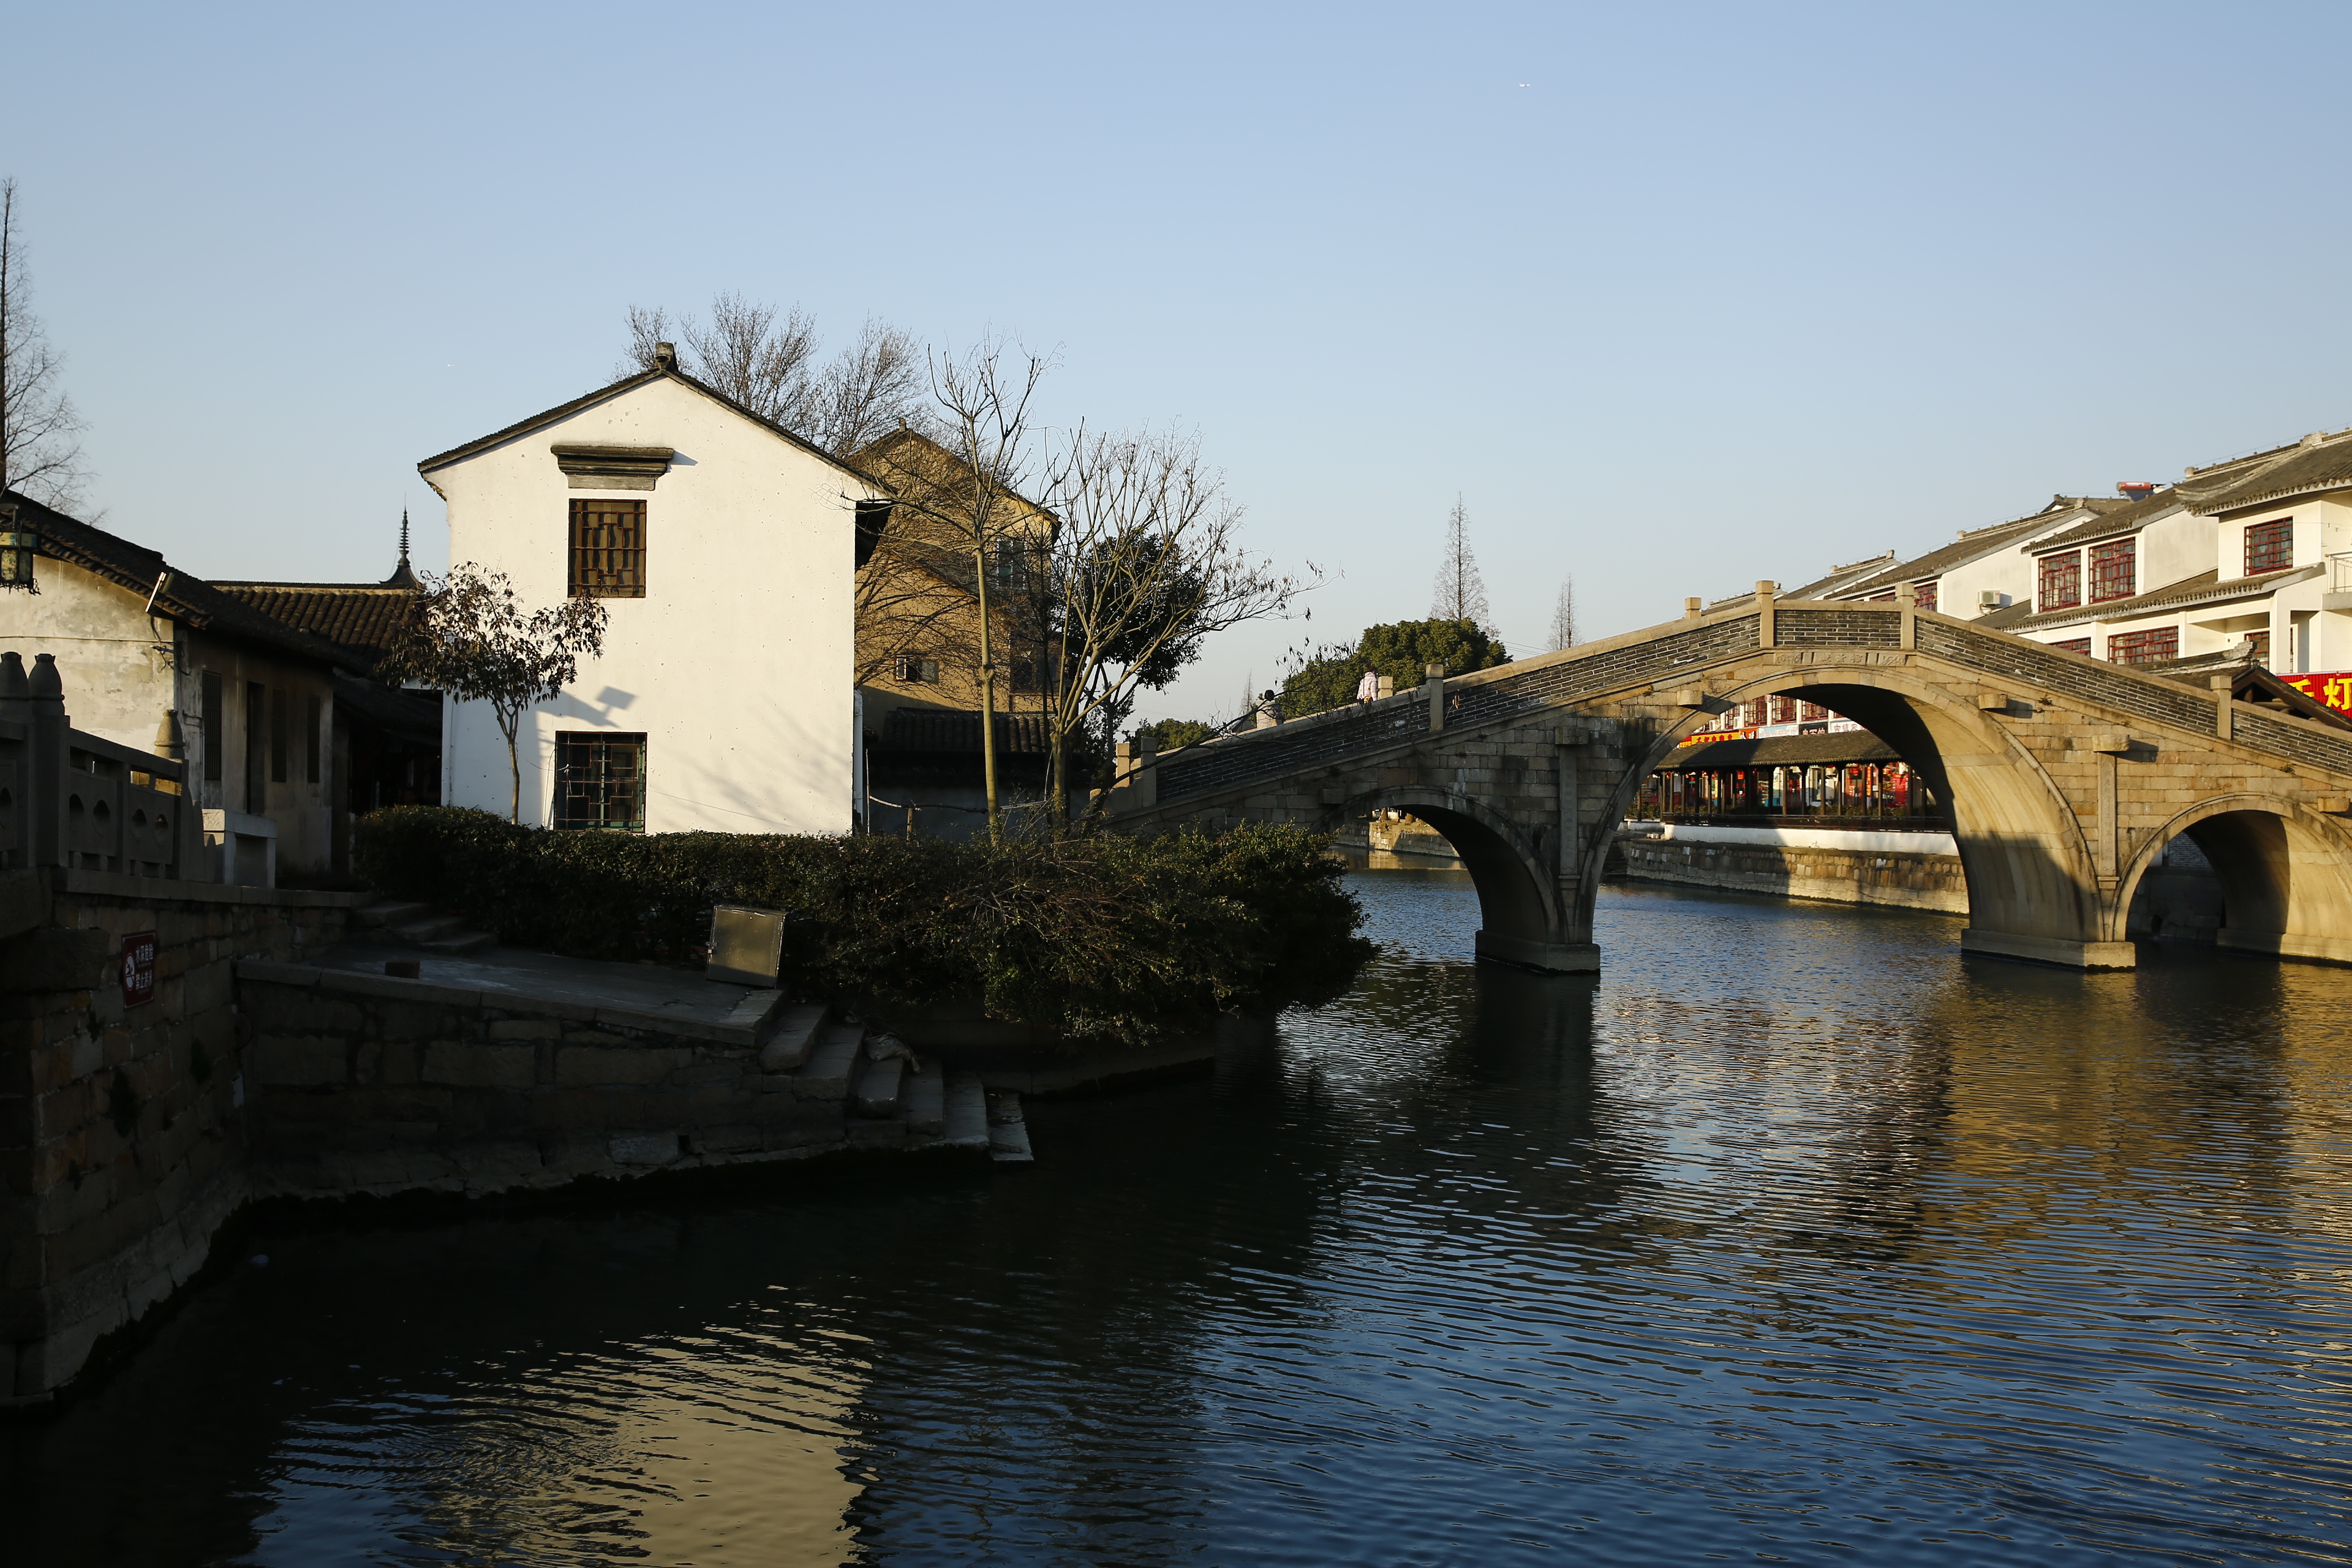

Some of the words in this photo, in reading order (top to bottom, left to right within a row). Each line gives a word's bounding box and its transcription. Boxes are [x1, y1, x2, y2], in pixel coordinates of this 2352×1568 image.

[135, 943, 153, 963] 水深危险
[135, 970, 153, 990] 禁止游泳
